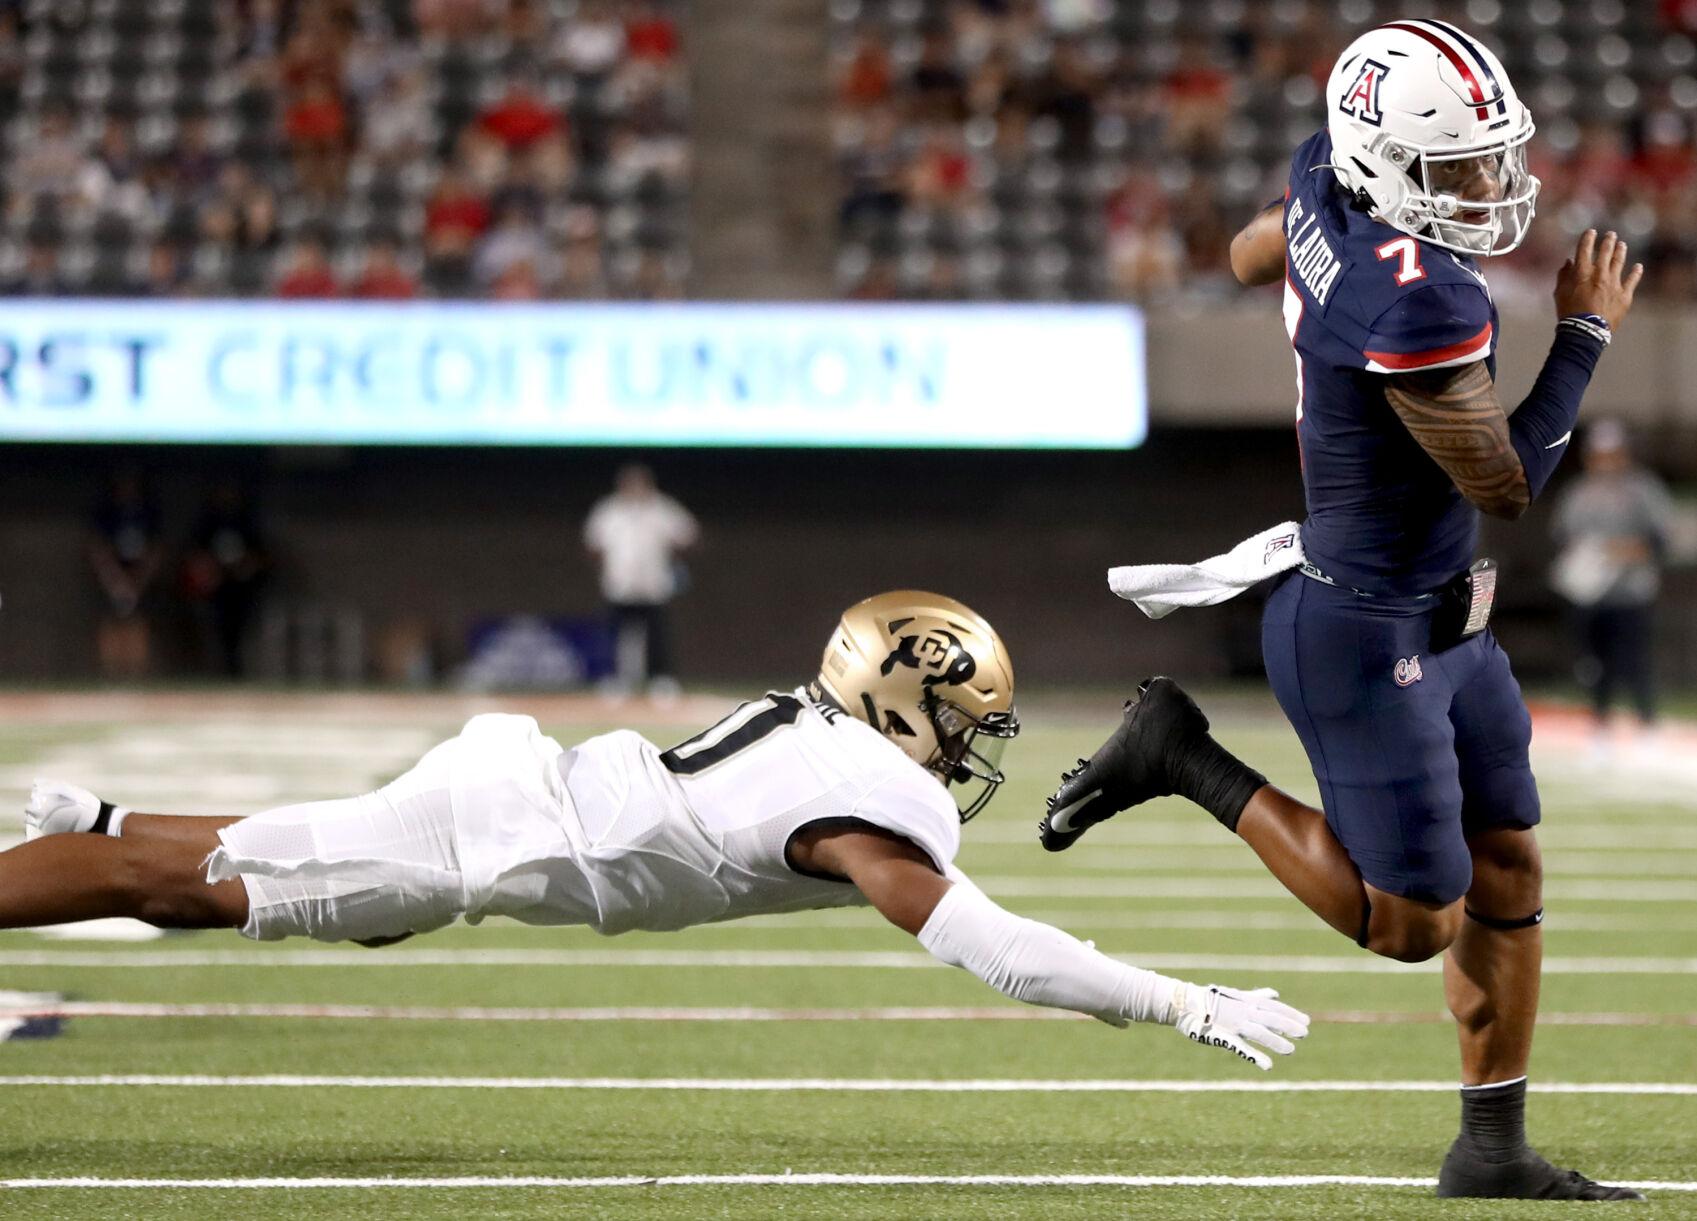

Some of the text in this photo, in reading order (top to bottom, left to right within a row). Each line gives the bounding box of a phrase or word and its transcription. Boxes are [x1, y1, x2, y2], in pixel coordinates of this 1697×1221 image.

[1340, 58, 1390, 127] A
[1289, 212, 1341, 306] LAURA
[1375, 236, 1428, 287] 7
[206, 331, 579, 408] CREDIT
[609, 332, 948, 410] UNION
